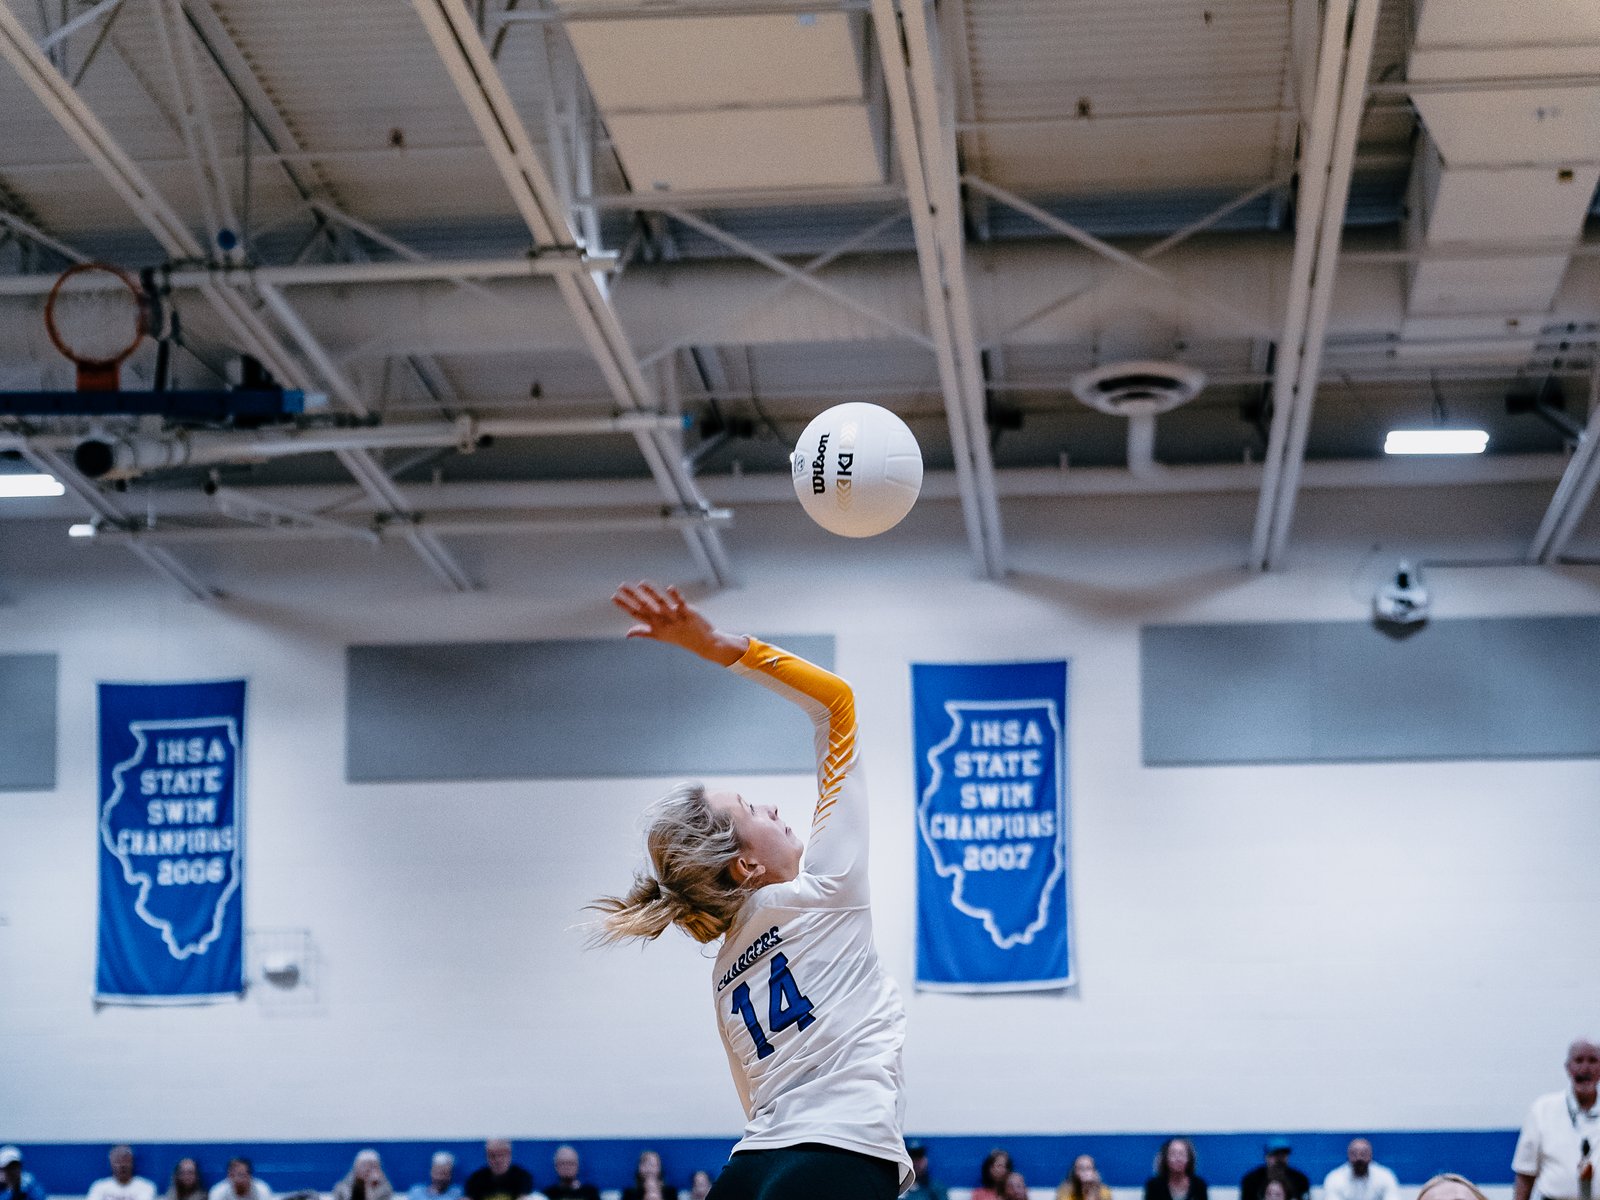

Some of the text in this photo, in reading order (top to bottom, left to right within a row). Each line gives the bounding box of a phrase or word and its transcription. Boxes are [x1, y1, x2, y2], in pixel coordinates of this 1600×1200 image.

[970, 719, 1043, 747] IHSA
[156, 736, 226, 765] IHSA
[954, 750, 1042, 778] STATE
[140, 767, 223, 796] STATE
[960, 781, 1034, 810] SWIM
[147, 798, 218, 826] SWIM
[930, 811, 1056, 841] CHAMPIONS
[117, 825, 234, 856] CHAMPIONS
[962, 844, 1034, 872] 2007
[717, 925, 783, 992] CHARGERS
[731, 951, 817, 1060] 14
